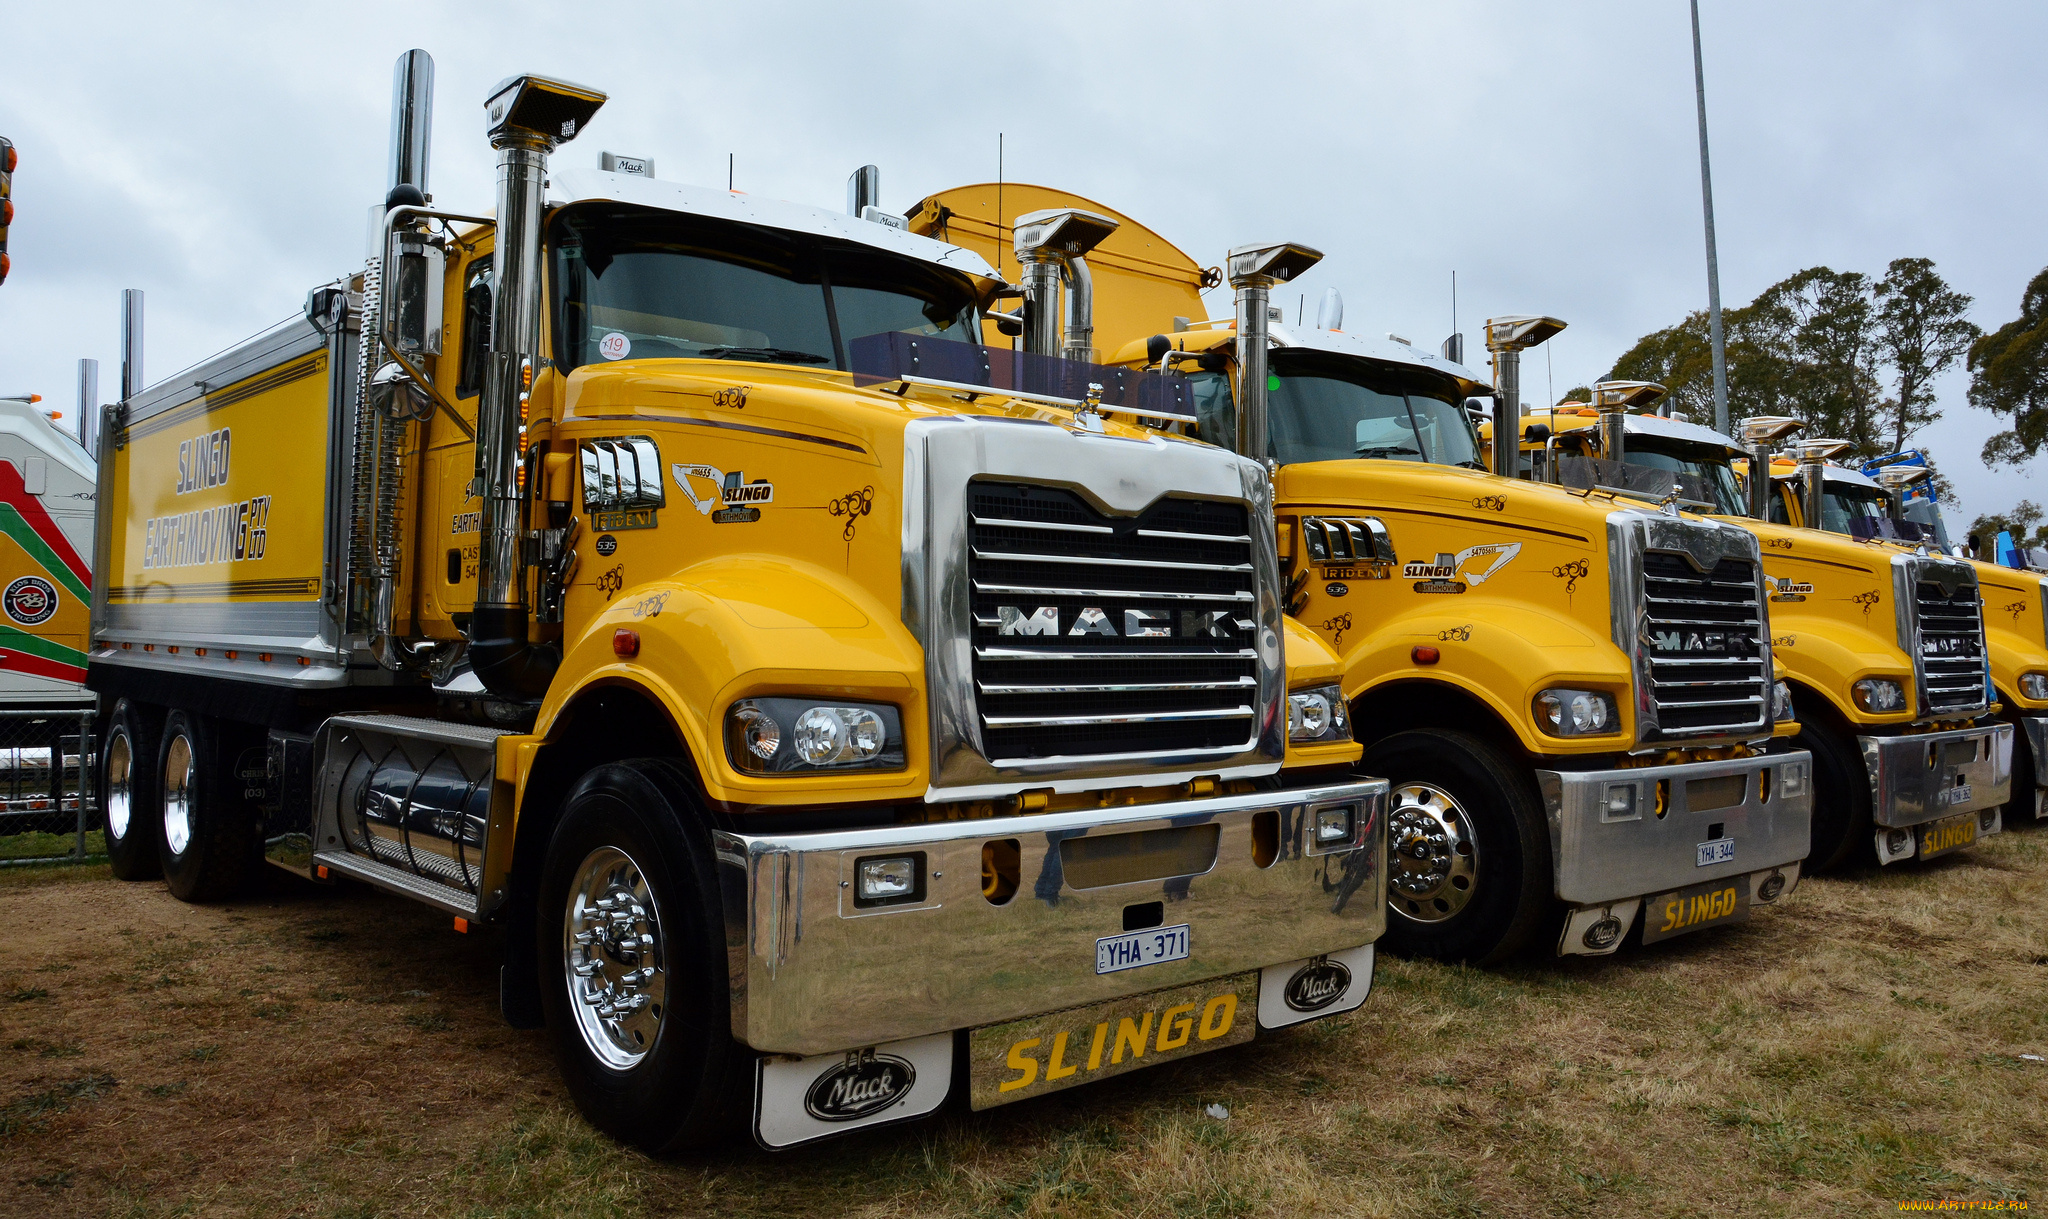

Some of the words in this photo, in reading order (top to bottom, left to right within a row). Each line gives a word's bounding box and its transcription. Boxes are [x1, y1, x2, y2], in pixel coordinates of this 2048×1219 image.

[618, 160, 644, 174] Mack
[880, 217, 900, 229] Mack
[176, 426, 231, 495] SLINGO
[725, 486, 771, 502] SLINGO
[249, 495, 272, 528] PTY
[594, 509, 653, 528] TRIDENT
[452, 512, 482, 535] EARTH
[143, 500, 249, 569] EARTHMOVING
[247, 528, 267, 560] LTD
[462, 548, 479, 560] CAS
[597, 541, 616, 550] 535
[1324, 564, 1387, 579] TRIDENT
[1404, 565, 1453, 577] SLINGO
[10, 580, 29, 593] KLOS
[31, 580, 52, 593] BROS
[11, 609, 51, 622] TRUCKING
[997, 606, 1232, 638] MACK
[1655, 631, 1750, 650] MACK
[244, 788, 266, 799] (03)
[1923, 821, 1975, 854] SLINGO
[1660, 887, 1736, 932] SLINGO
[1296, 971, 1339, 1001] Mack
[999, 993, 1238, 1093] SLINGO
[823, 1066, 896, 1110] Mack
